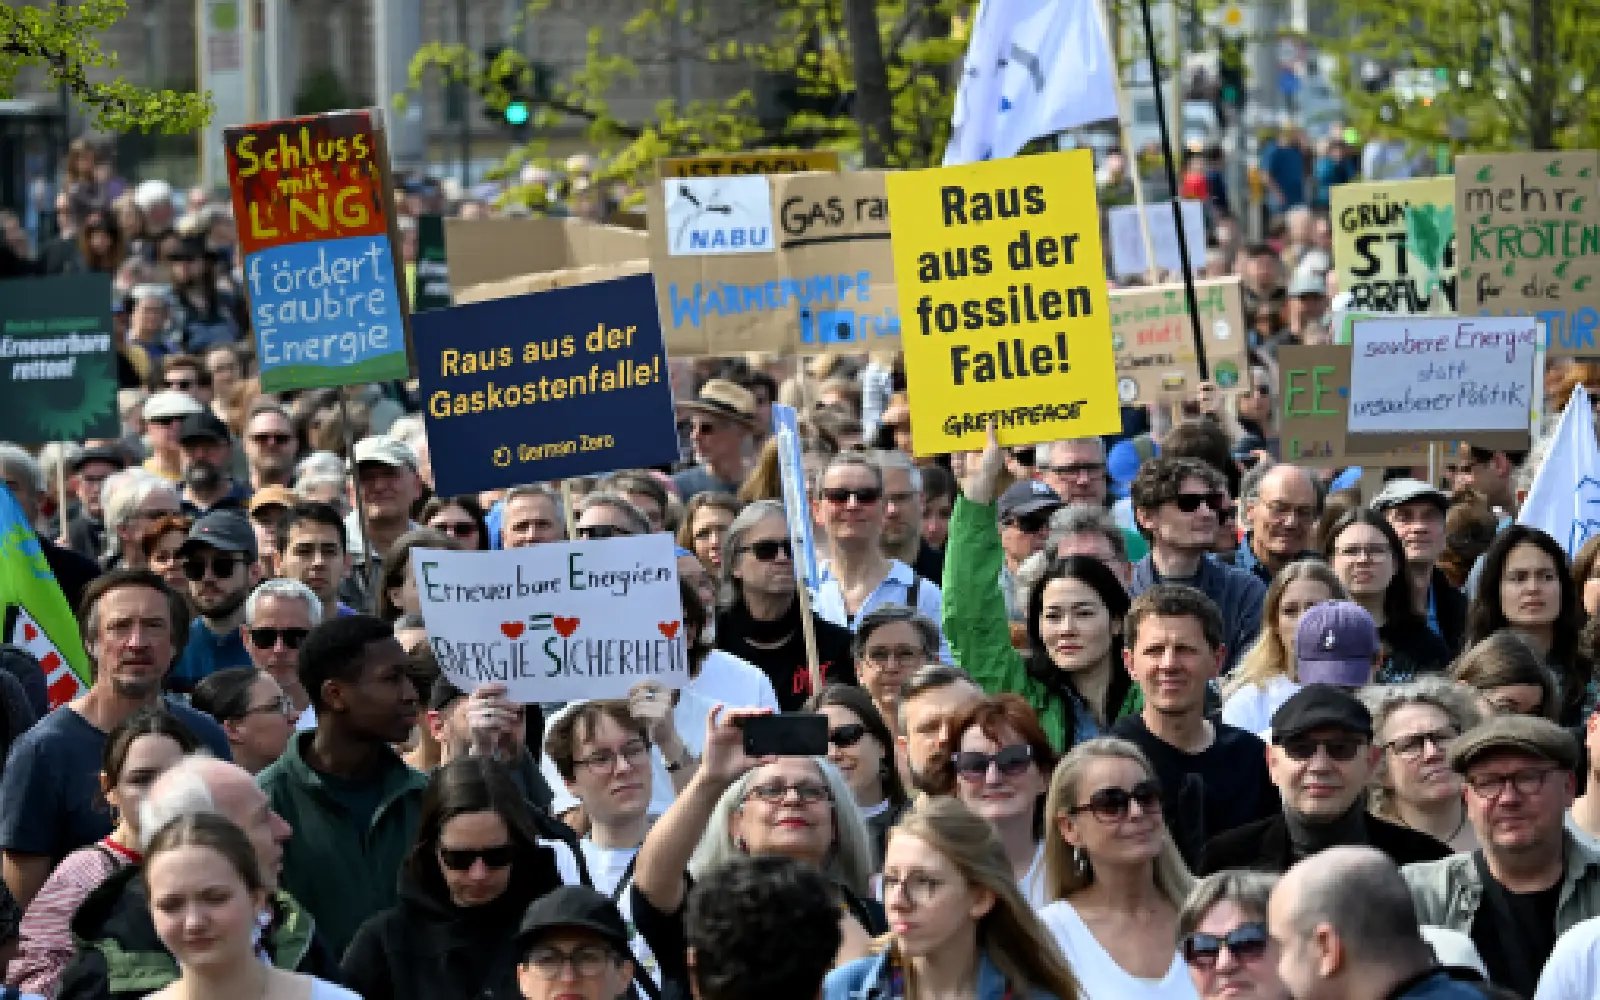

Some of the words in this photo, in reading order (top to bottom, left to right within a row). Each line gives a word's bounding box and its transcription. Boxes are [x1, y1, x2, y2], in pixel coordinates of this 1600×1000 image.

[235, 126, 370, 177] Schluss
[276, 169, 329, 196] mit
[1465, 174, 1576, 212] mehr
[250, 186, 370, 238] LNG
[780, 195, 845, 235] GAS
[940, 183, 1047, 228] Raus
[689, 226, 770, 249] NABU
[917, 243, 994, 284] aus
[1007, 229, 1081, 271] der
[1470, 218, 1600, 263] KRÖTEN
[248, 240, 385, 297] fördert
[1520, 272, 1561, 300] die
[914, 281, 1094, 336] fossilen
[258, 322, 389, 364] Energie
[440, 347, 514, 378] Raus
[522, 335, 577, 364] aus
[585, 322, 638, 353] der
[949, 331, 1072, 386] Falle!
[1364, 328, 1450, 358] saubere
[1454, 321, 1538, 364] Energie
[427, 354, 662, 420] Gaskostenfalle!
[1417, 359, 1469, 383] statt
[517, 442, 577, 462] German
[579, 433, 616, 452] Zero
[421, 561, 562, 603] Erneuerbare
[568, 551, 673, 598] Energien
[430, 635, 537, 682] ENERGIE
[542, 635, 684, 678] SICHERHEIT
